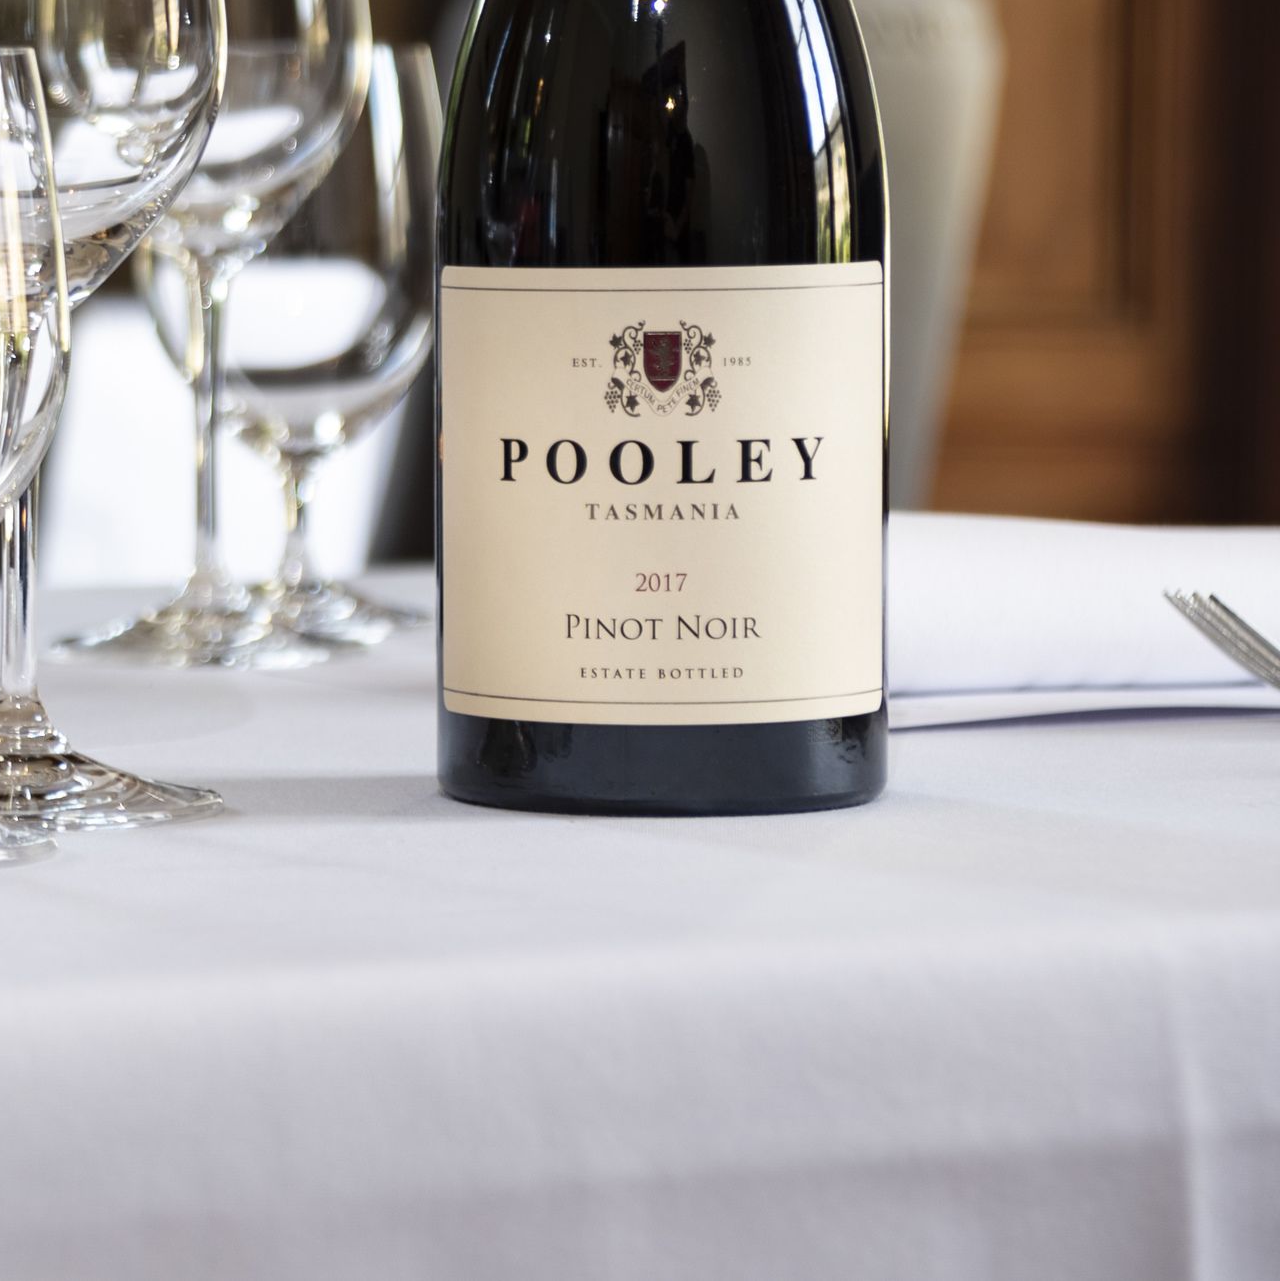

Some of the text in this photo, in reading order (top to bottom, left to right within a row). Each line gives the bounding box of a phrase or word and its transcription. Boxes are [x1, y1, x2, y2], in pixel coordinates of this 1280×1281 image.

[572, 357, 752, 368] EST. 1985
[626, 377, 699, 413] CERTUM PETE FINEM
[500, 437, 823, 485] POOLEY
[585, 502, 740, 521] TASMANIA
[634, 572, 688, 593] 2017
[565, 613, 762, 640] PINOT NOIR
[580, 666, 744, 680] ESTATE BOTTLED
